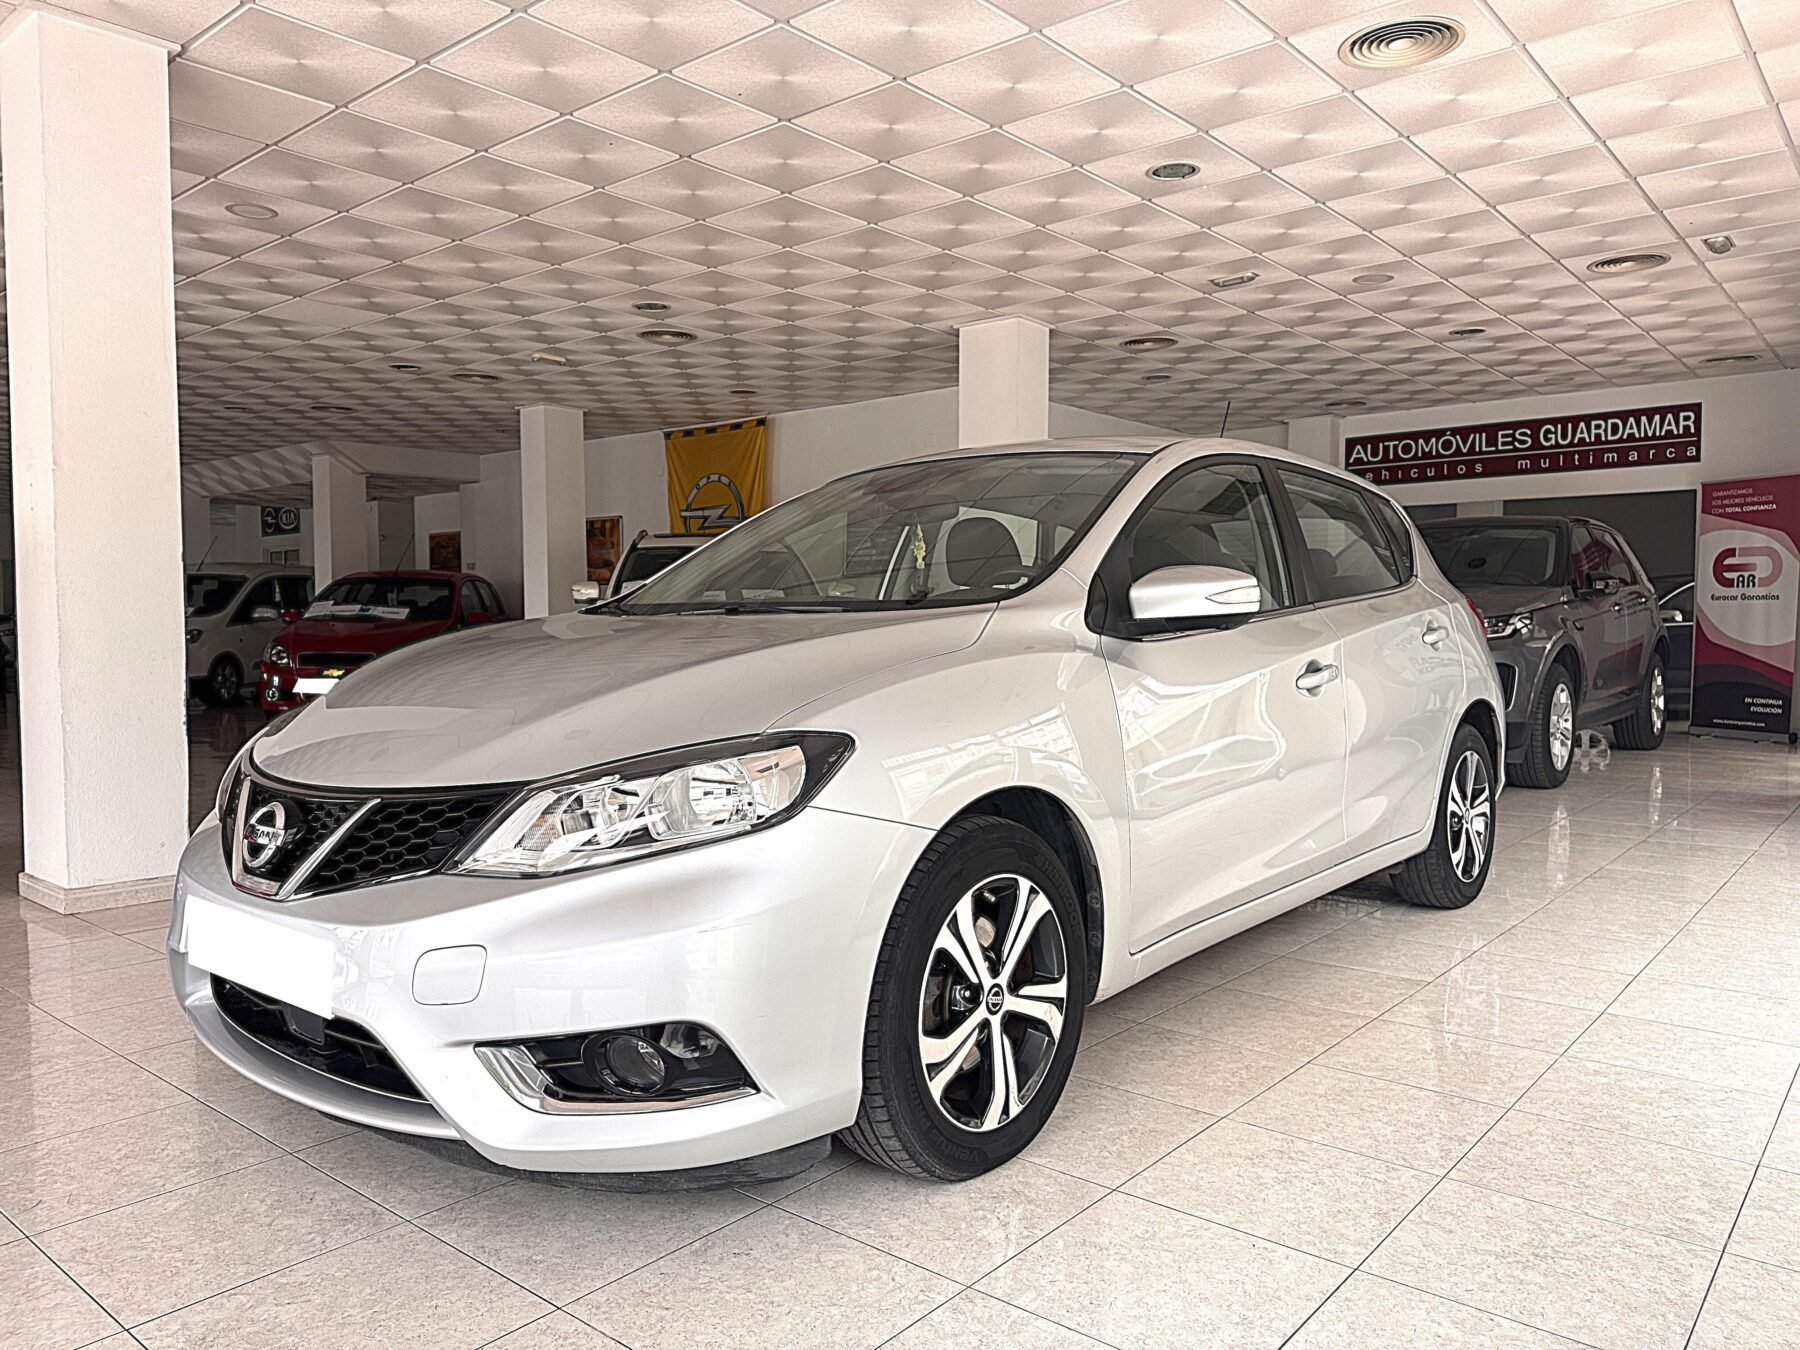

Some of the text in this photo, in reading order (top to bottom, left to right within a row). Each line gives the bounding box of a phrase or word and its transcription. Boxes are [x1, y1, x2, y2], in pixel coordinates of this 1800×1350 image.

[1349, 411, 1696, 463] AUTOMÓVILES GUARDAMAR
[1518, 446, 1696, 469] multimarca
[695, 475, 732, 490] OPEL
[1712, 488, 1752, 497] GARANTIZAMOS
[1722, 497, 1744, 505] MEJORES
[1743, 503, 1776, 512] CONFIANZA
[1710, 593, 1739, 601] Eurocar
